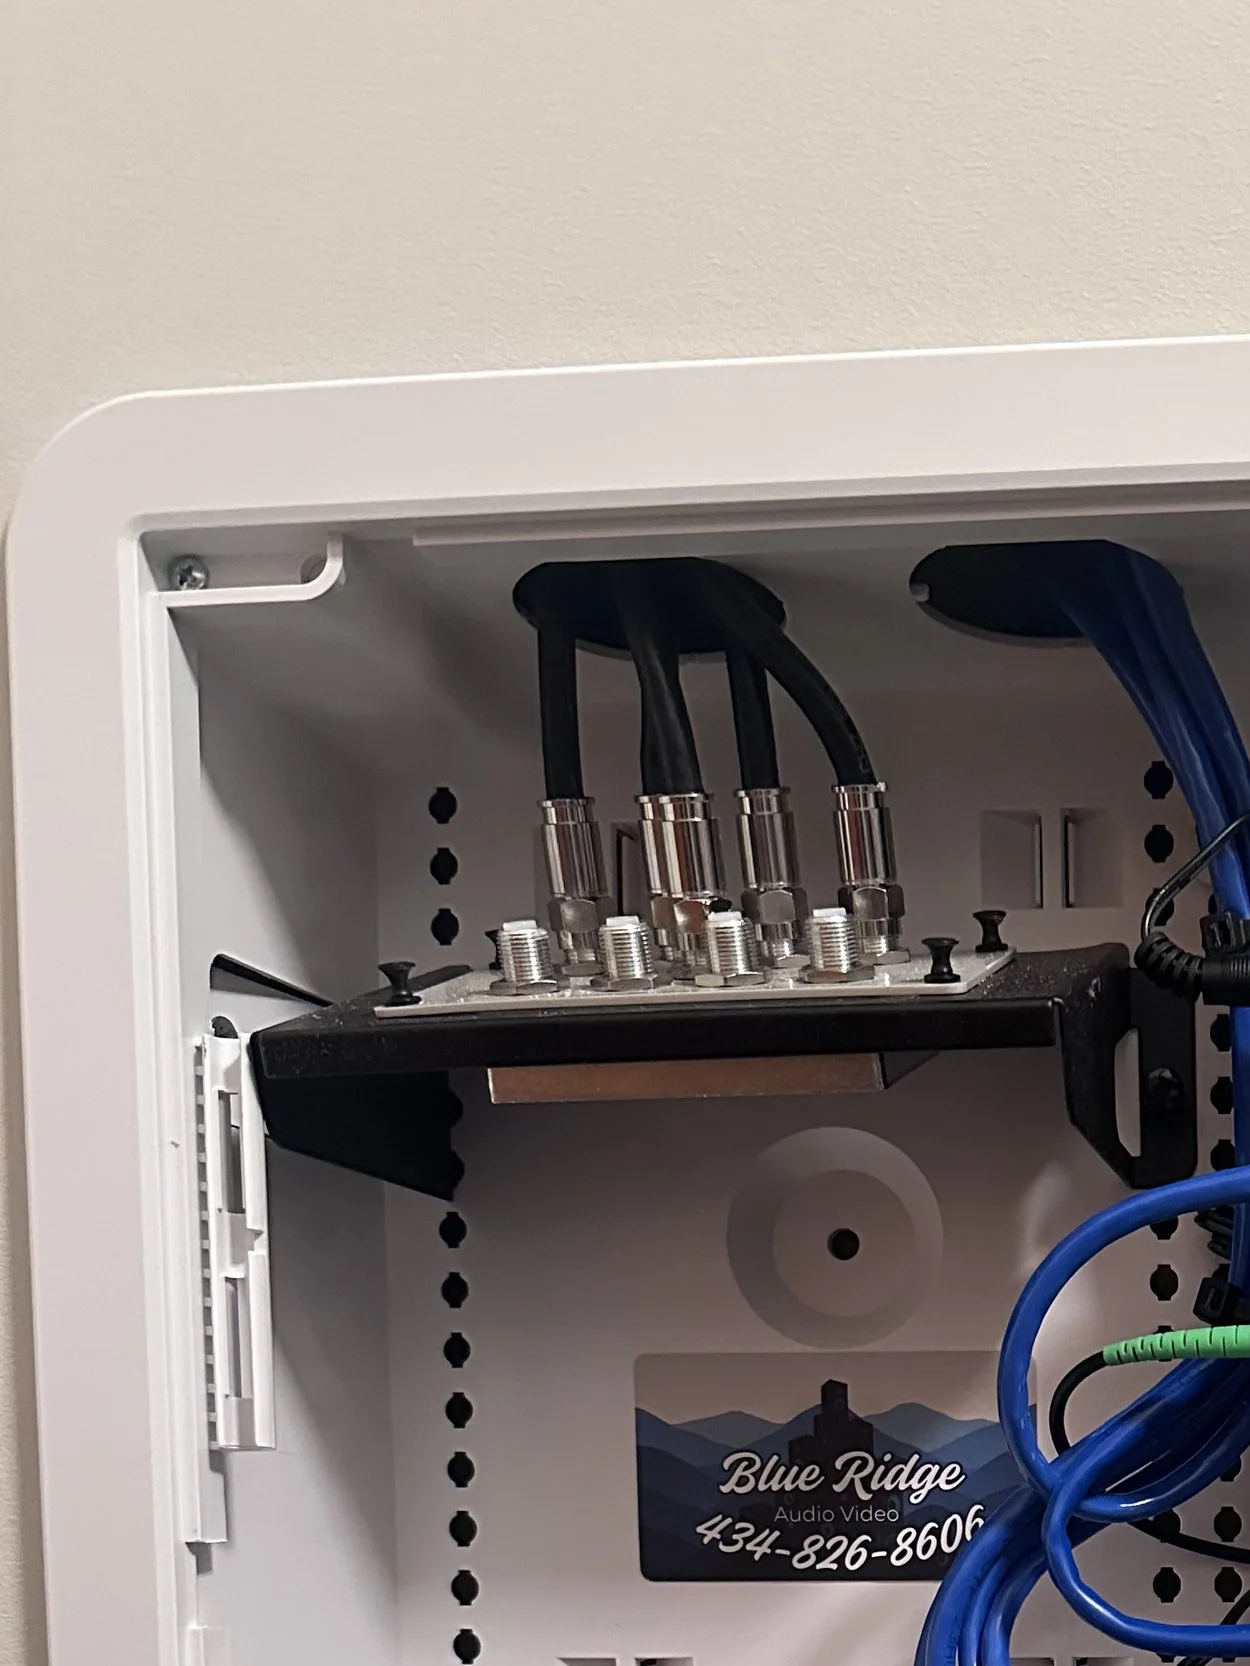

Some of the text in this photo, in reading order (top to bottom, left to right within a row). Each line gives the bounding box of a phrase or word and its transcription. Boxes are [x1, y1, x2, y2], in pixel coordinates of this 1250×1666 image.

[719, 1451, 966, 1504] Blue Ridge
[774, 1506, 899, 1523] Audio Video
